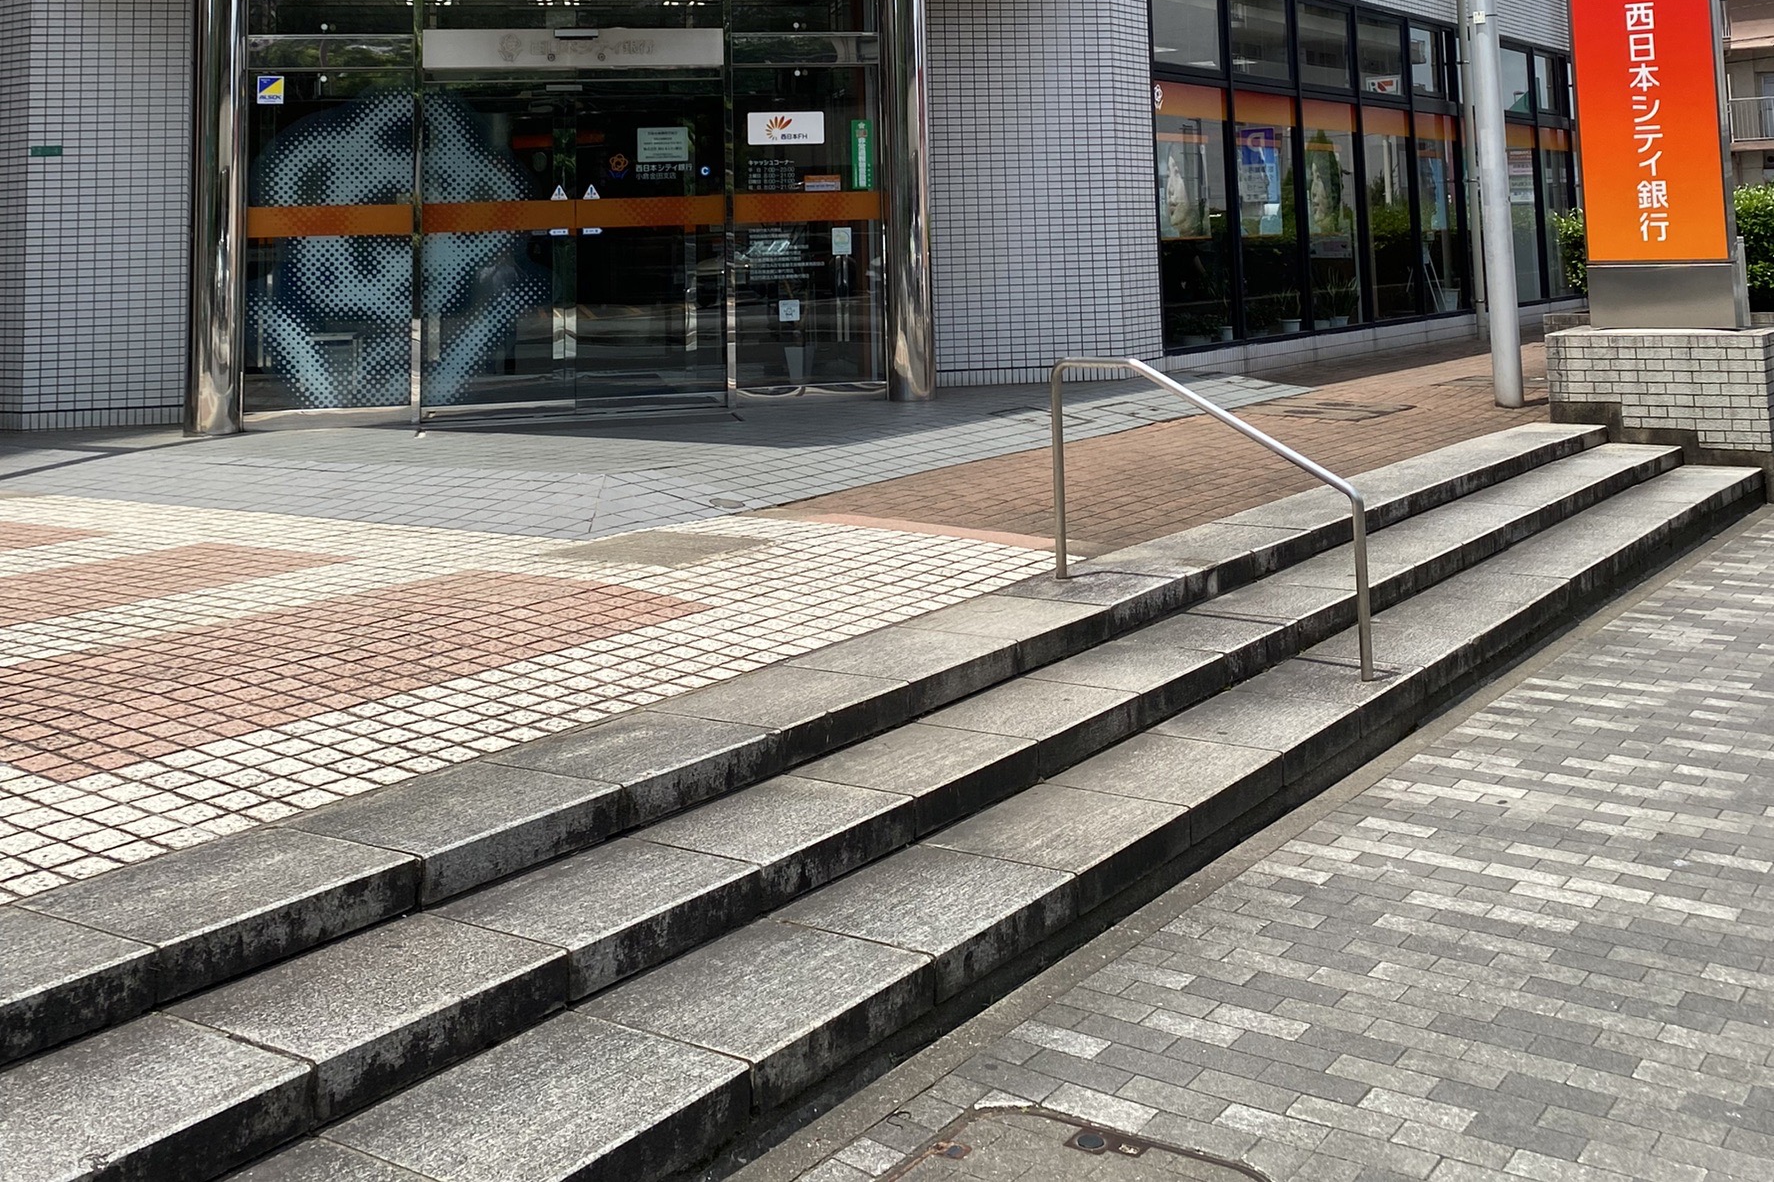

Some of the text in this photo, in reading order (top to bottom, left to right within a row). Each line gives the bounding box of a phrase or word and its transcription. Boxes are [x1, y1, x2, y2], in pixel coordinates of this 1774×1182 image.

[635, 163, 693, 173] 西日本シティ銀行
[1624, 1, 1670, 242] 西日本シティ銀行
